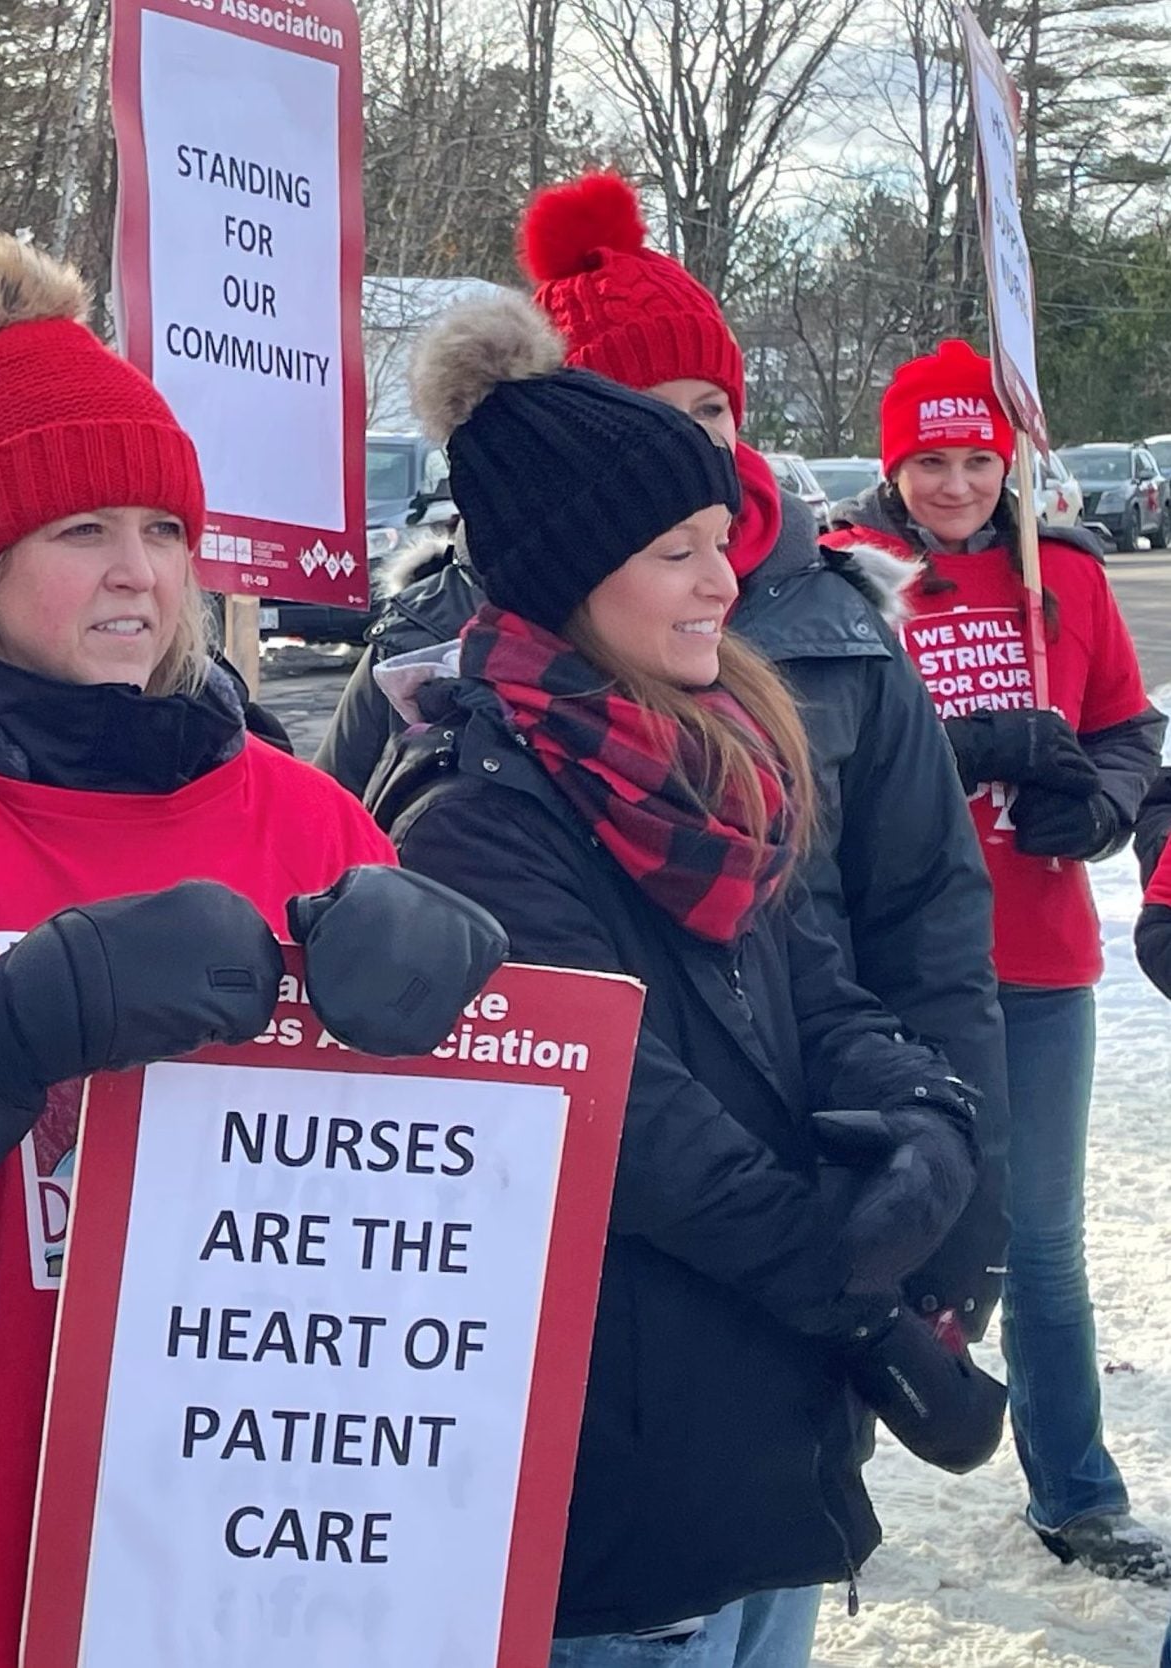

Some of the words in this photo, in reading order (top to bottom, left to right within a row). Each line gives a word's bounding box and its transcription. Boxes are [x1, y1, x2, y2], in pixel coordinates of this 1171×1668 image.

[220, 0, 344, 49] Association
[176, 143, 312, 208] STANDING
[224, 214, 274, 258] FOR
[222, 274, 277, 319] OUR
[166, 322, 331, 387] COMMUNITY
[920, 397, 991, 420] MSNA
[912, 625, 956, 648] WE
[958, 620, 1022, 641] WILL
[918, 641, 1027, 676] STRIKE
[979, 669, 1032, 690] OUR
[316, 1021, 589, 1072] Aciation
[220, 1110, 476, 1178] NURSES
[198, 1209, 331, 1268] ARE
[351, 1217, 474, 1275] THE
[166, 1305, 388, 1370] HEART
[403, 1316, 488, 1372] OF
[181, 1405, 458, 1469] PATIENT
[223, 1504, 393, 1565] CARE
